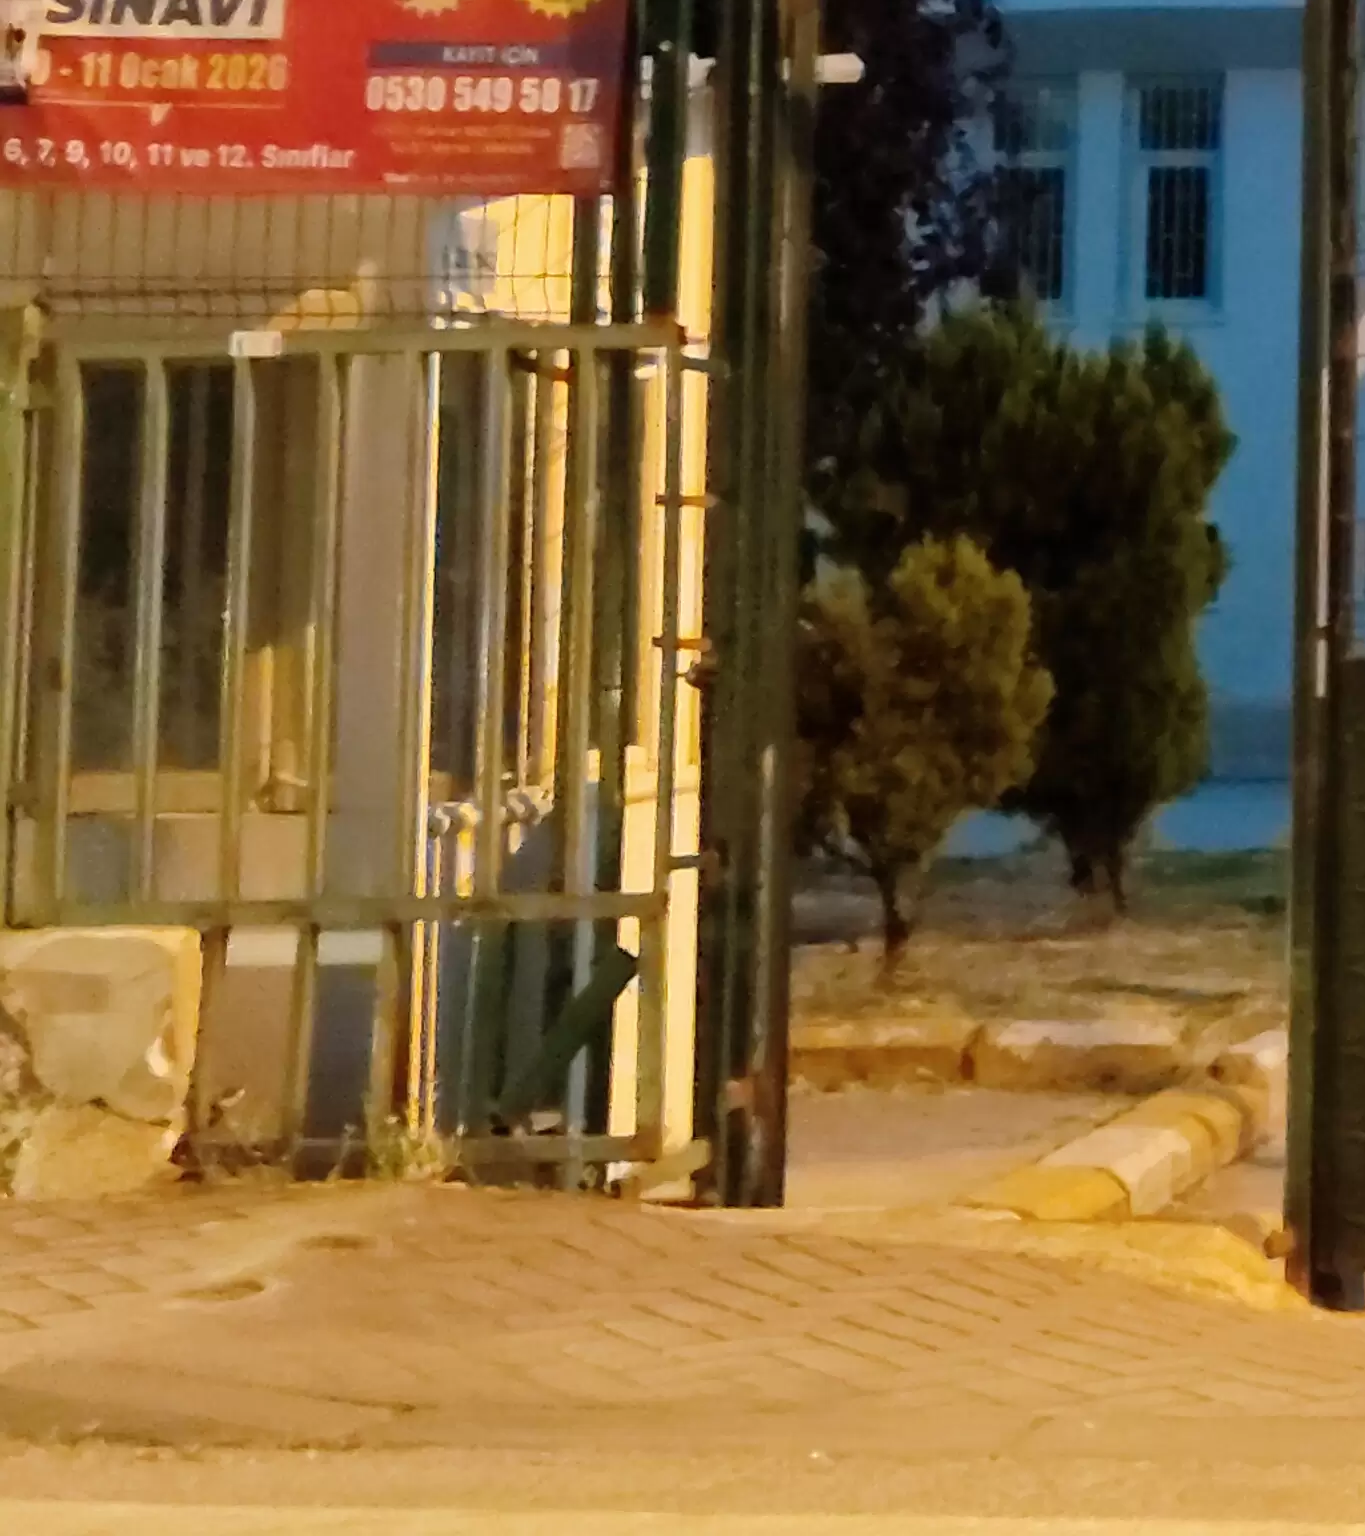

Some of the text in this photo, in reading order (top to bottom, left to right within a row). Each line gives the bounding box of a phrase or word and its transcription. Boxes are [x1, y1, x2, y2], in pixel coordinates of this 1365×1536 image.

[81, 51, 114, 88] 11
[119, 51, 200, 90] Ocak
[206, 53, 290, 91] 2026
[366, 75, 447, 112] 0530
[454, 76, 514, 113] 549
[568, 77, 600, 113] 17
[180, 146, 211, 168] ve
